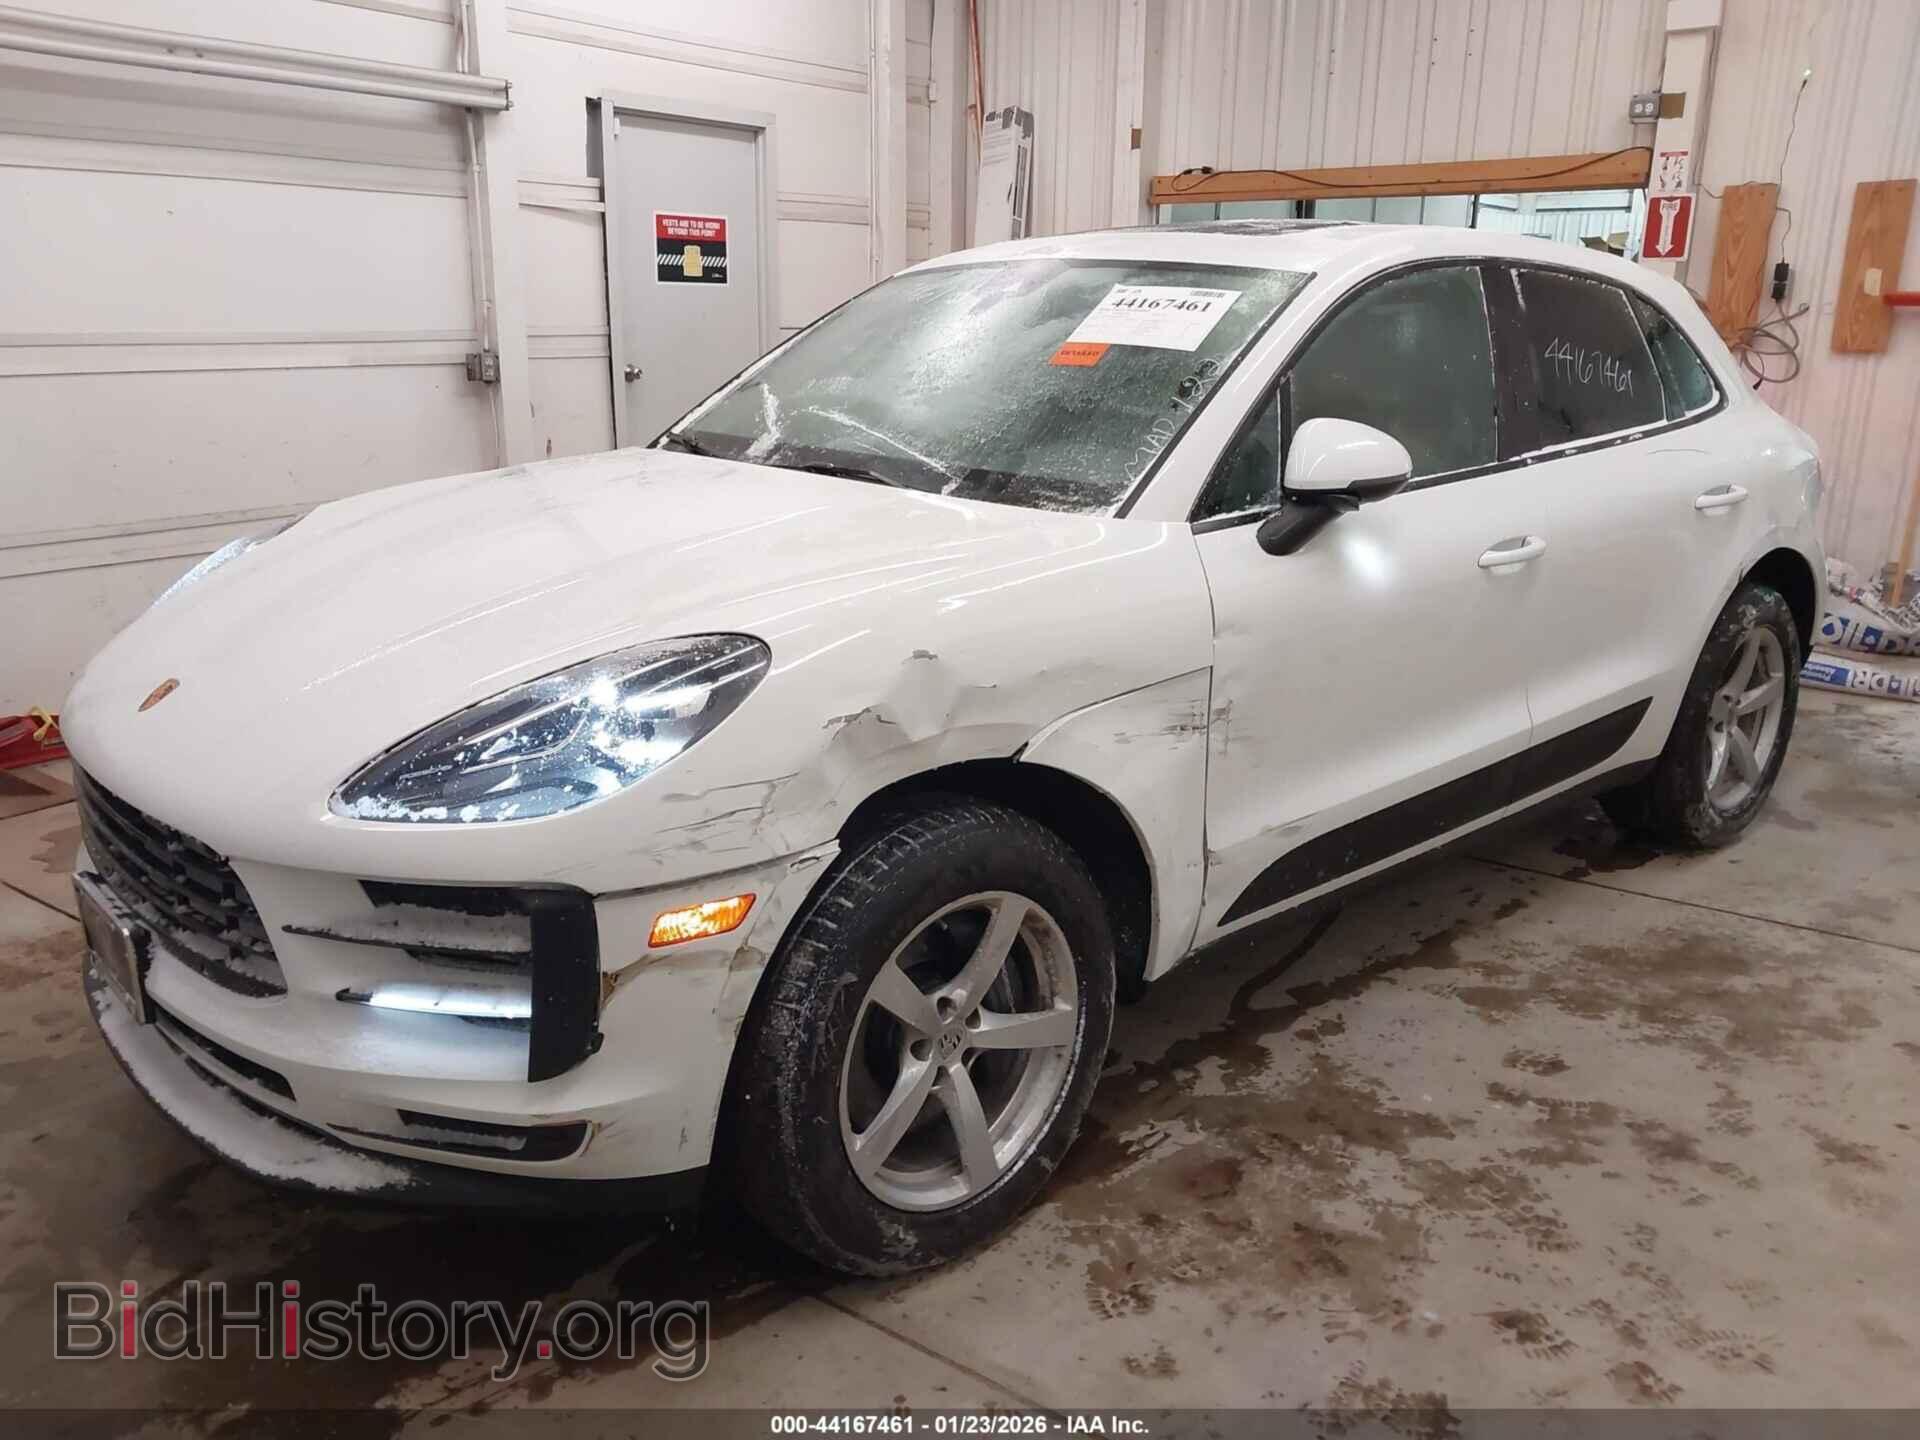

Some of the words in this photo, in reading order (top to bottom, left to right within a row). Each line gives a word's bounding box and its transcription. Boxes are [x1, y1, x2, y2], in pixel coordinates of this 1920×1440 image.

[1662, 202, 1679, 210] FIRE
[680, 220, 689, 228] ARE
[667, 227, 688, 236] BEYOND
[689, 229, 700, 237] THIS
[1111, 298, 1212, 312] 44167461
[1544, 336, 1634, 399] 44167461
